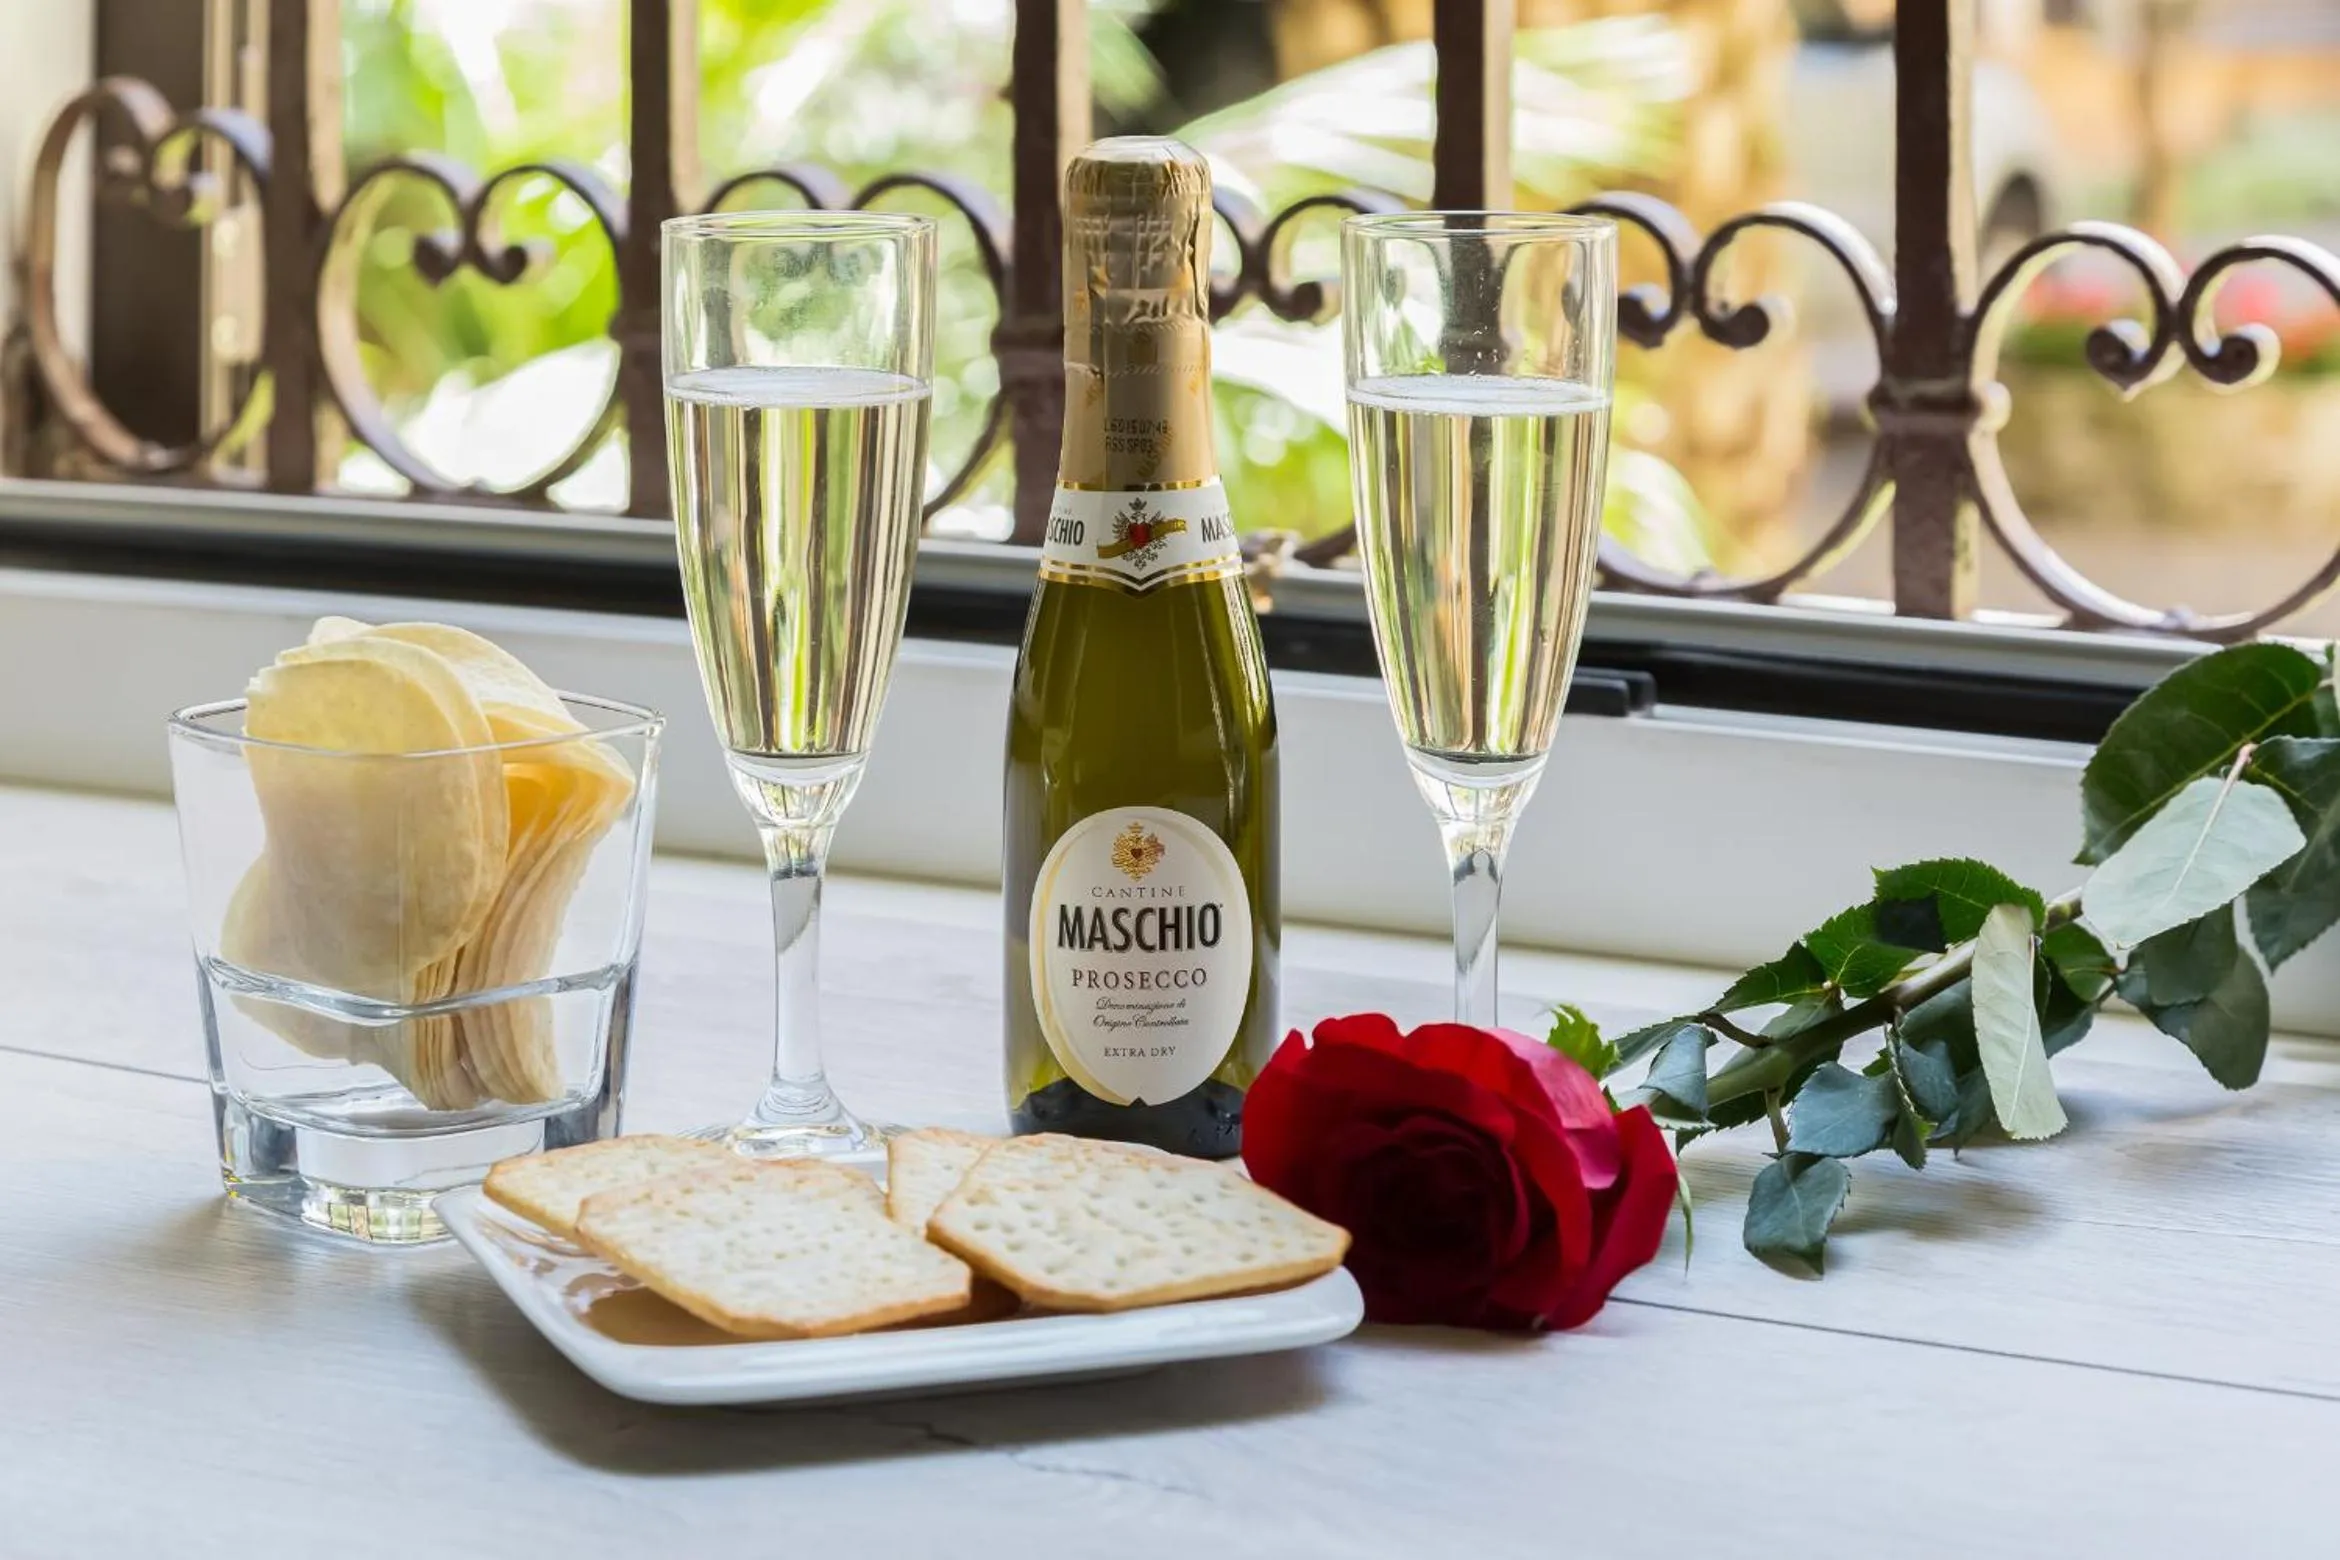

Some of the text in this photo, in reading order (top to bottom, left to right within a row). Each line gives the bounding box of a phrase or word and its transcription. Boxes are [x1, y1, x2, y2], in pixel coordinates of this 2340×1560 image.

[1091, 886, 1186, 898] CANTINE
[1057, 902, 1223, 953] MASCHIO
[1072, 967, 1207, 990] PROSECCO
[1093, 1014, 1132, 1032] Origine
[1104, 1045, 1176, 1057] EXTRA DRY
